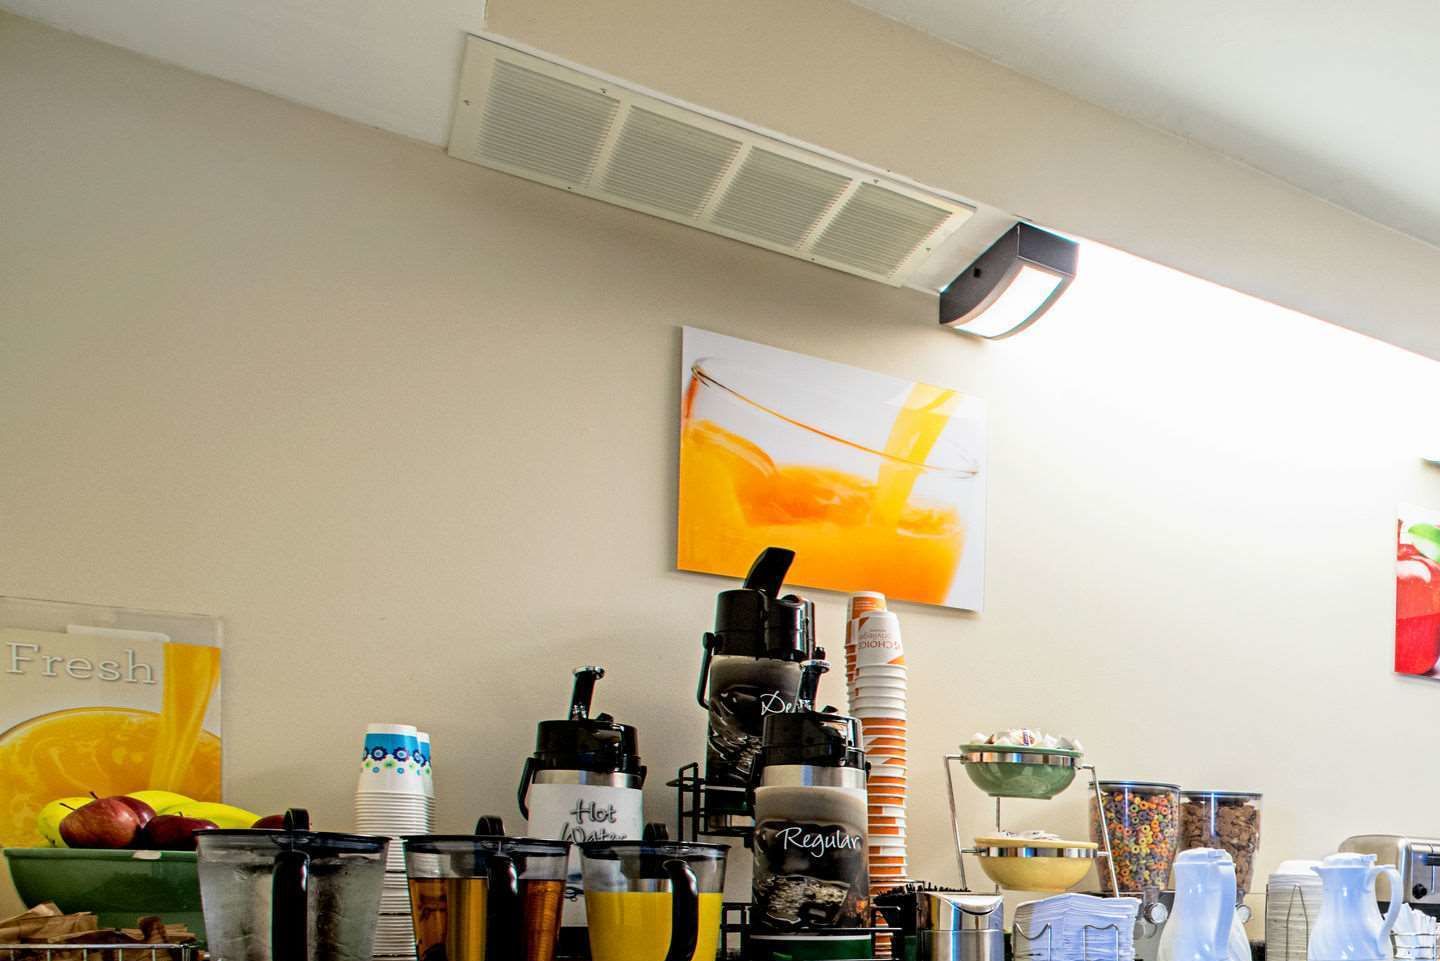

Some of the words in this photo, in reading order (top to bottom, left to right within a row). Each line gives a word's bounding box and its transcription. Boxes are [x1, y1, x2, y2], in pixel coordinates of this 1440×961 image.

[6, 640, 157, 684] Fresh
[570, 799, 616, 824] Hot
[776, 827, 861, 857] Regular
